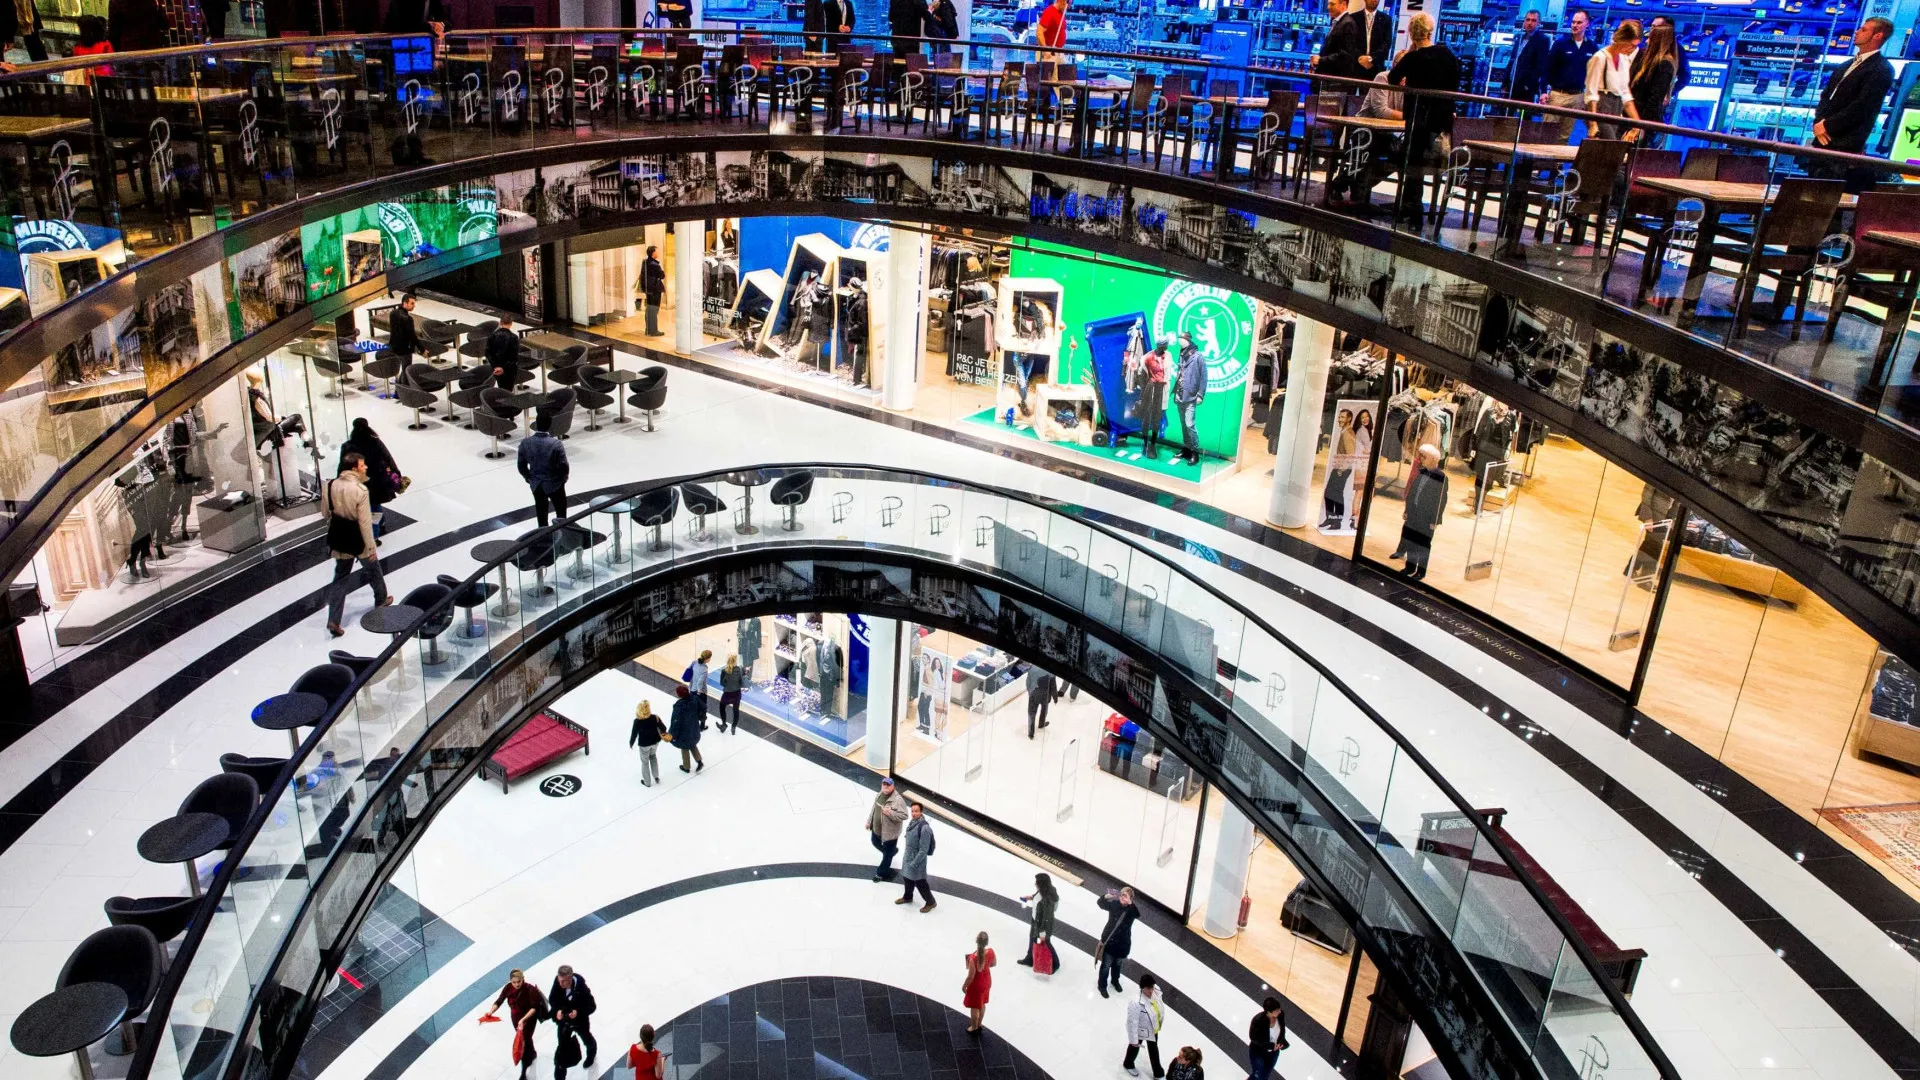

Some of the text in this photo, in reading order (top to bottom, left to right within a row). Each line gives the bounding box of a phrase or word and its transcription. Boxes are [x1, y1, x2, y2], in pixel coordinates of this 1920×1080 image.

[1248, 10, 1331, 26] KAFFEEWELTEN
[1747, 45, 1772, 53] Tablet
[1173, 283, 1232, 310] BERLIN
[956, 353, 974, 365] P&C
[954, 371, 973, 383] VON
[956, 363, 974, 374] NEU
[975, 367, 986, 377] IM
[1402, 596, 1434, 613] PEEK
